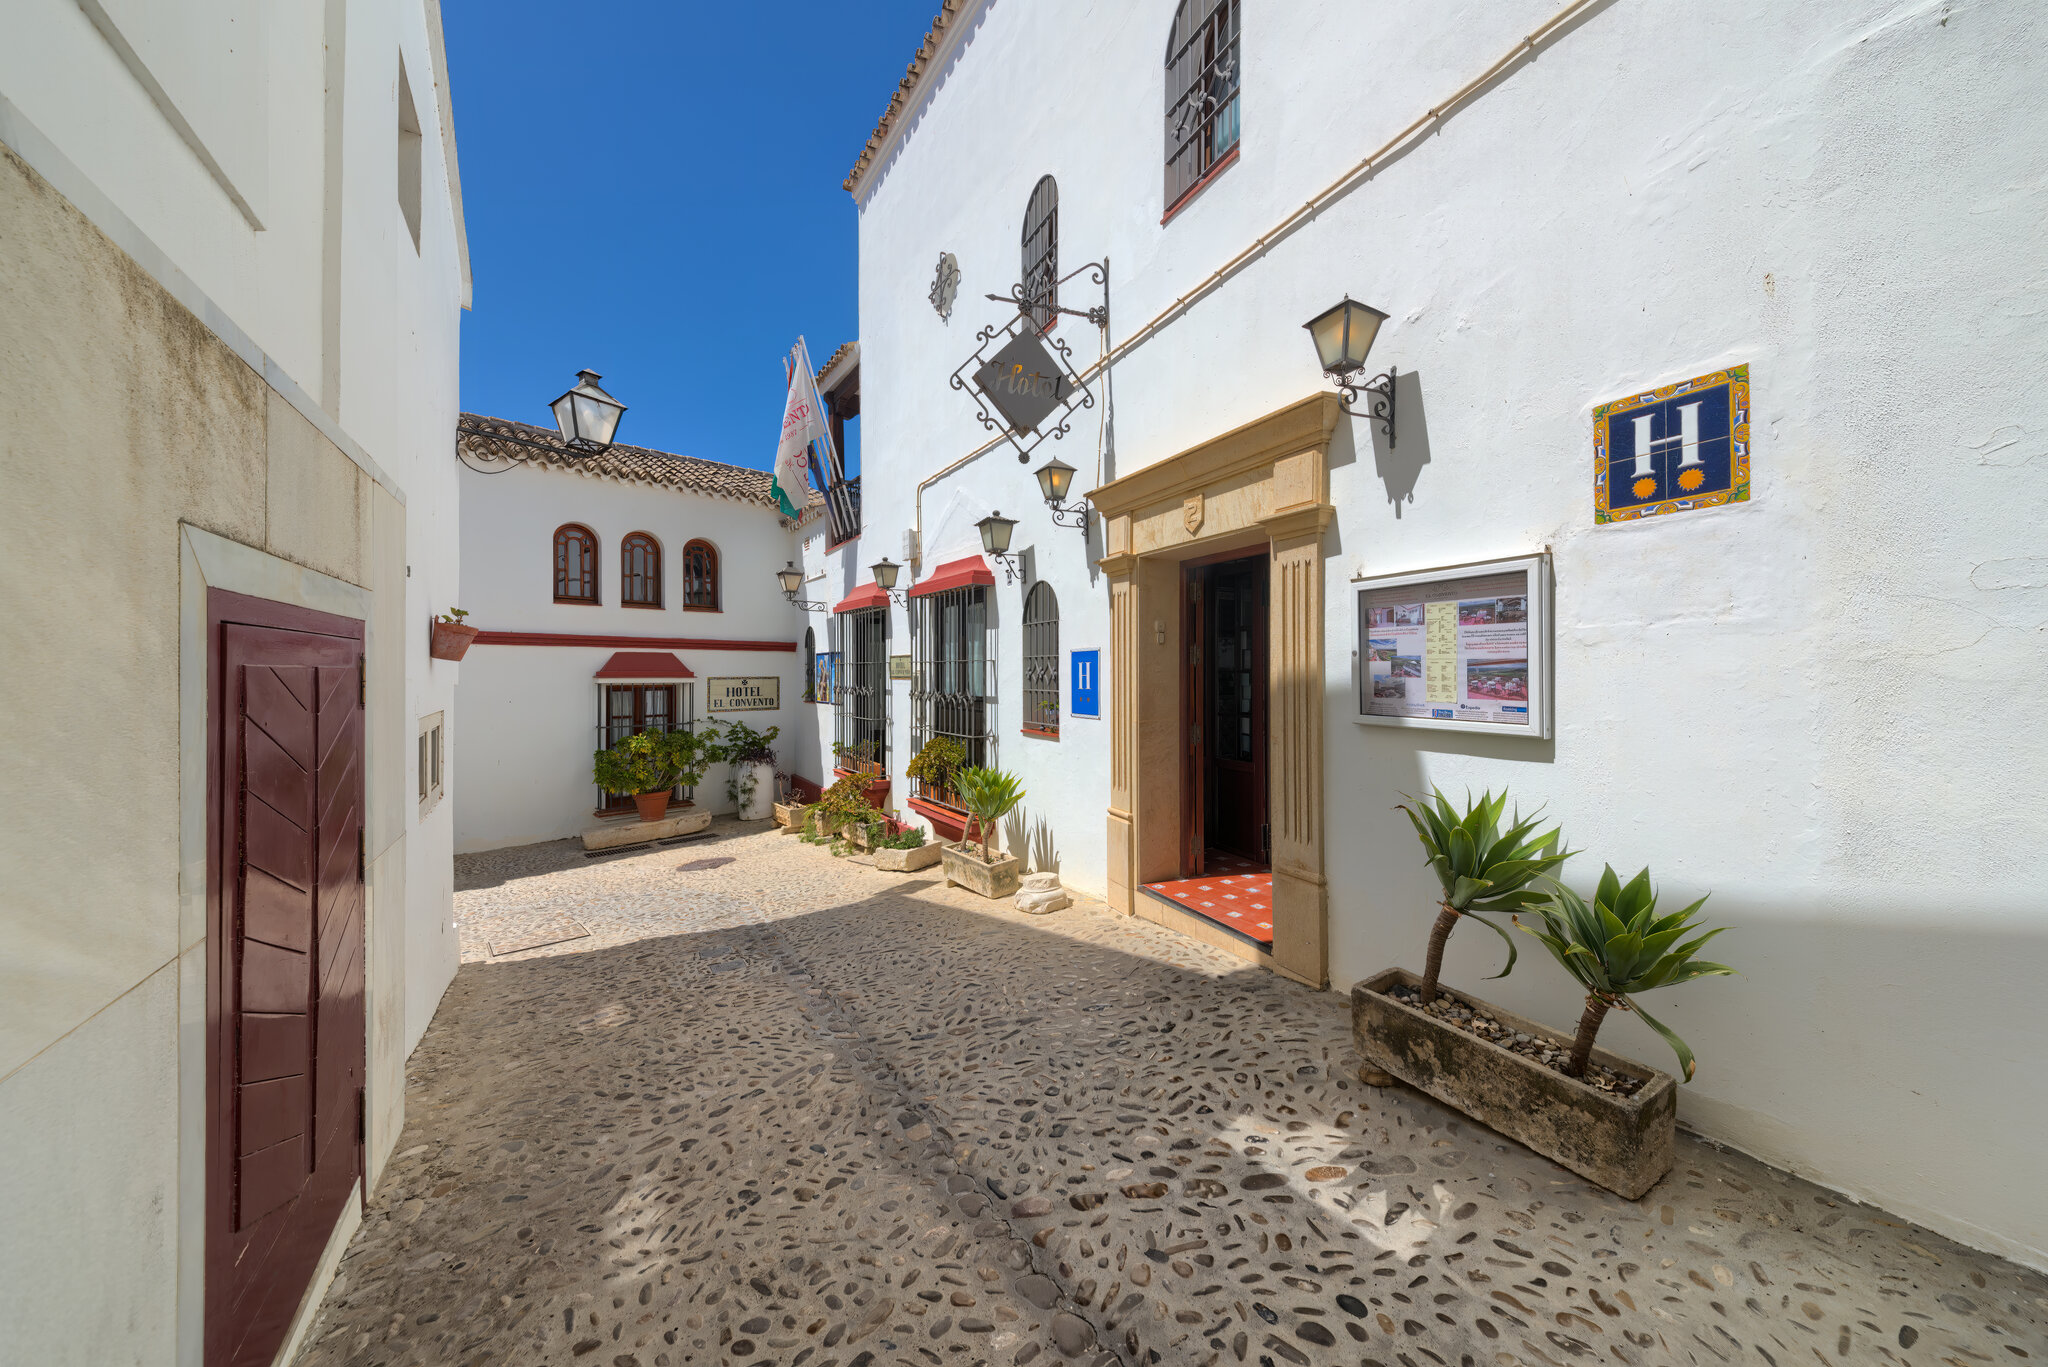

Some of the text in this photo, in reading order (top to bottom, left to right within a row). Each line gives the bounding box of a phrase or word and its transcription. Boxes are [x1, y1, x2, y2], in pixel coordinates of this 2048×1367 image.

[1631, 401, 1705, 478] H
[1188, 505, 1198, 524] 2
[1077, 662, 1092, 690] H
[726, 687, 763, 697] HOTEL
[714, 697, 774, 707] EL CONVENTO
